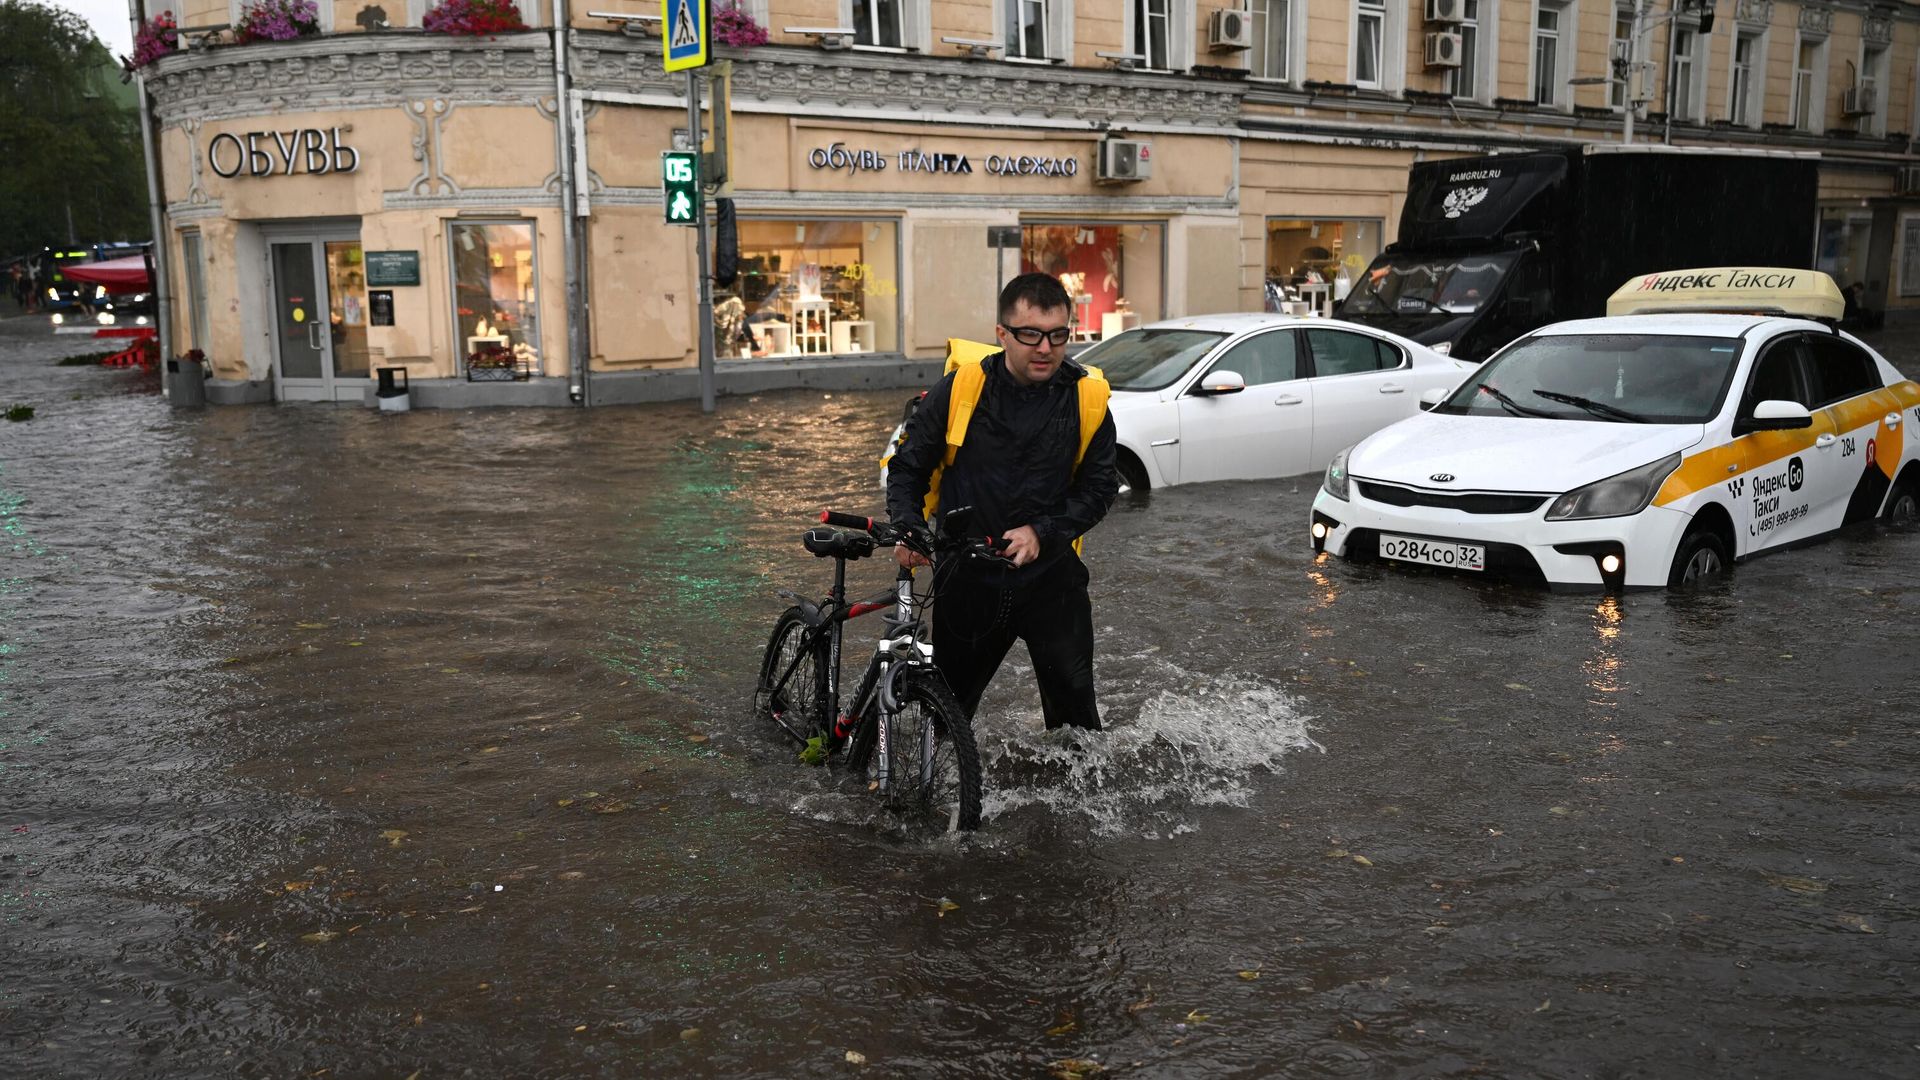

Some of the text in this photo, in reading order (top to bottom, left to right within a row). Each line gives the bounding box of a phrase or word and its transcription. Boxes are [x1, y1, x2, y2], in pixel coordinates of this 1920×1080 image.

[209, 127, 360, 179] ОБУВЬ
[665, 158, 692, 181] 05
[1449, 169, 1501, 182] RAMGRUZ.RU
[1637, 269, 1796, 292] Яндекс Такси
[1841, 437, 1856, 458] 284
[1753, 464, 1802, 498] Яндекс Go
[1753, 495, 1780, 519] Такси
[1757, 503, 1808, 536] (495) 999-99-99
[1459, 560, 1472, 568] RUS
[1460, 547, 1477, 563] 32
[879, 719, 887, 754] ZOOM
